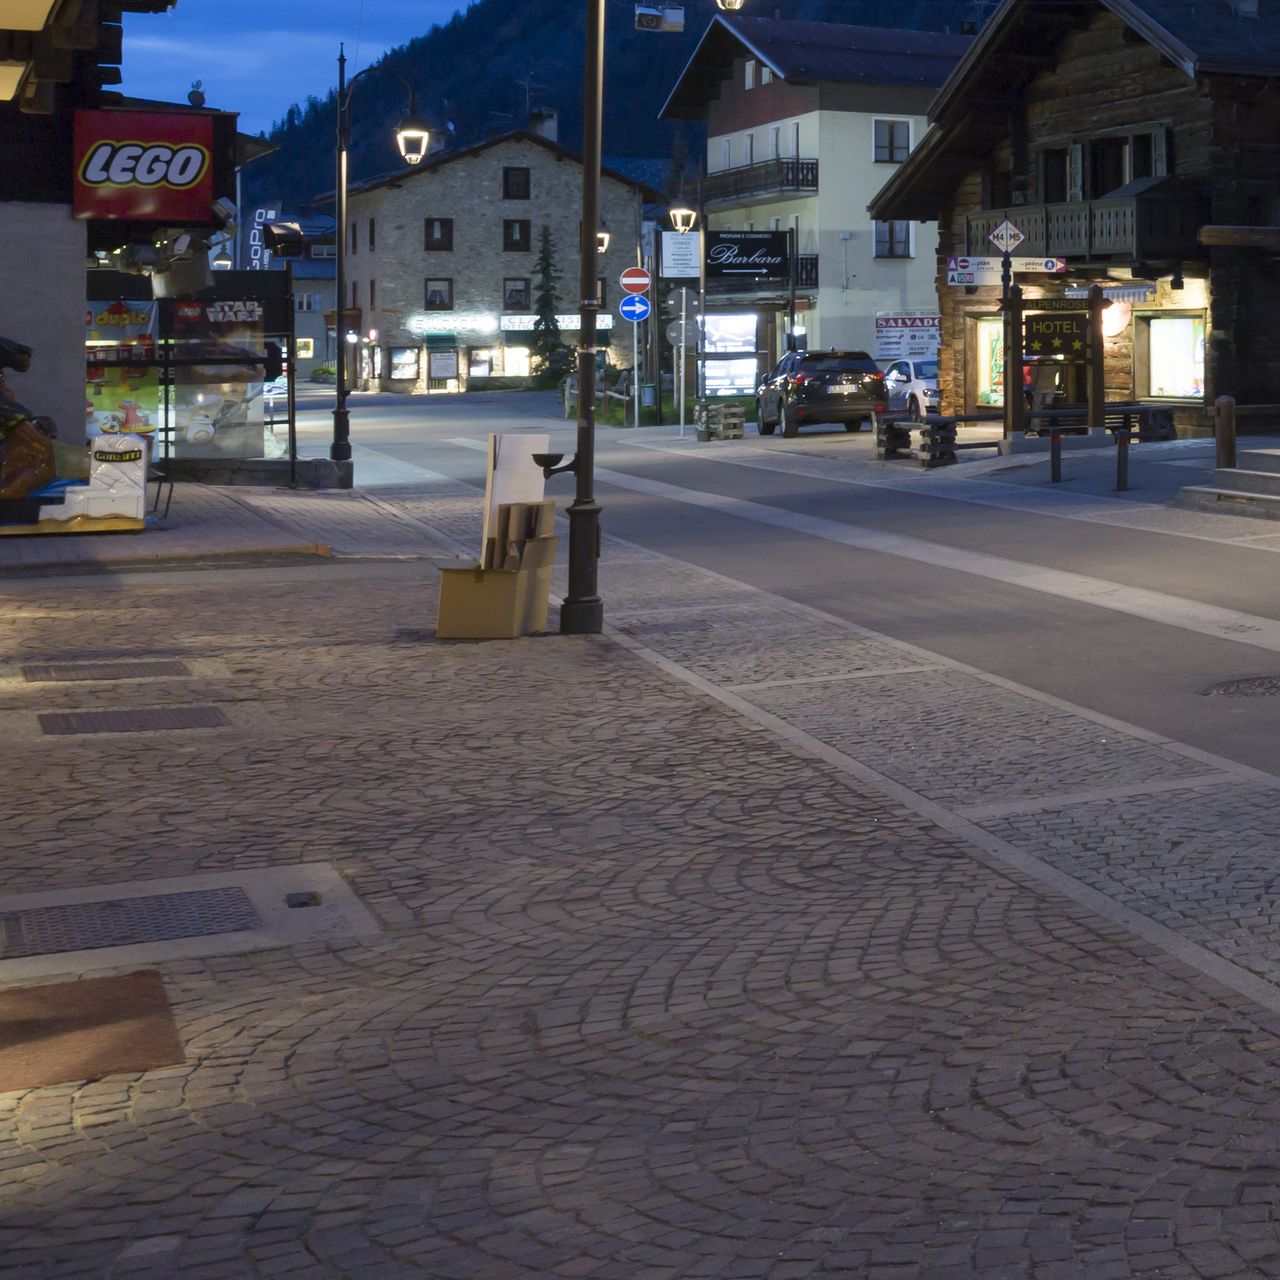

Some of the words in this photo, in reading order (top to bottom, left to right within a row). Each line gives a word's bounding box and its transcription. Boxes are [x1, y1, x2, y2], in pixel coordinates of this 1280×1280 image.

[83, 143, 206, 186] LEGO
[992, 233, 1004, 241] M4
[1009, 233, 1021, 241] M5
[707, 243, 782, 265] Barbara
[213, 301, 259, 311] STAR
[1026, 300, 1088, 310] ALPENROSE
[96, 311, 149, 329] duplo
[206, 308, 263, 322] WARS
[1032, 321, 1081, 334] HOTEL
